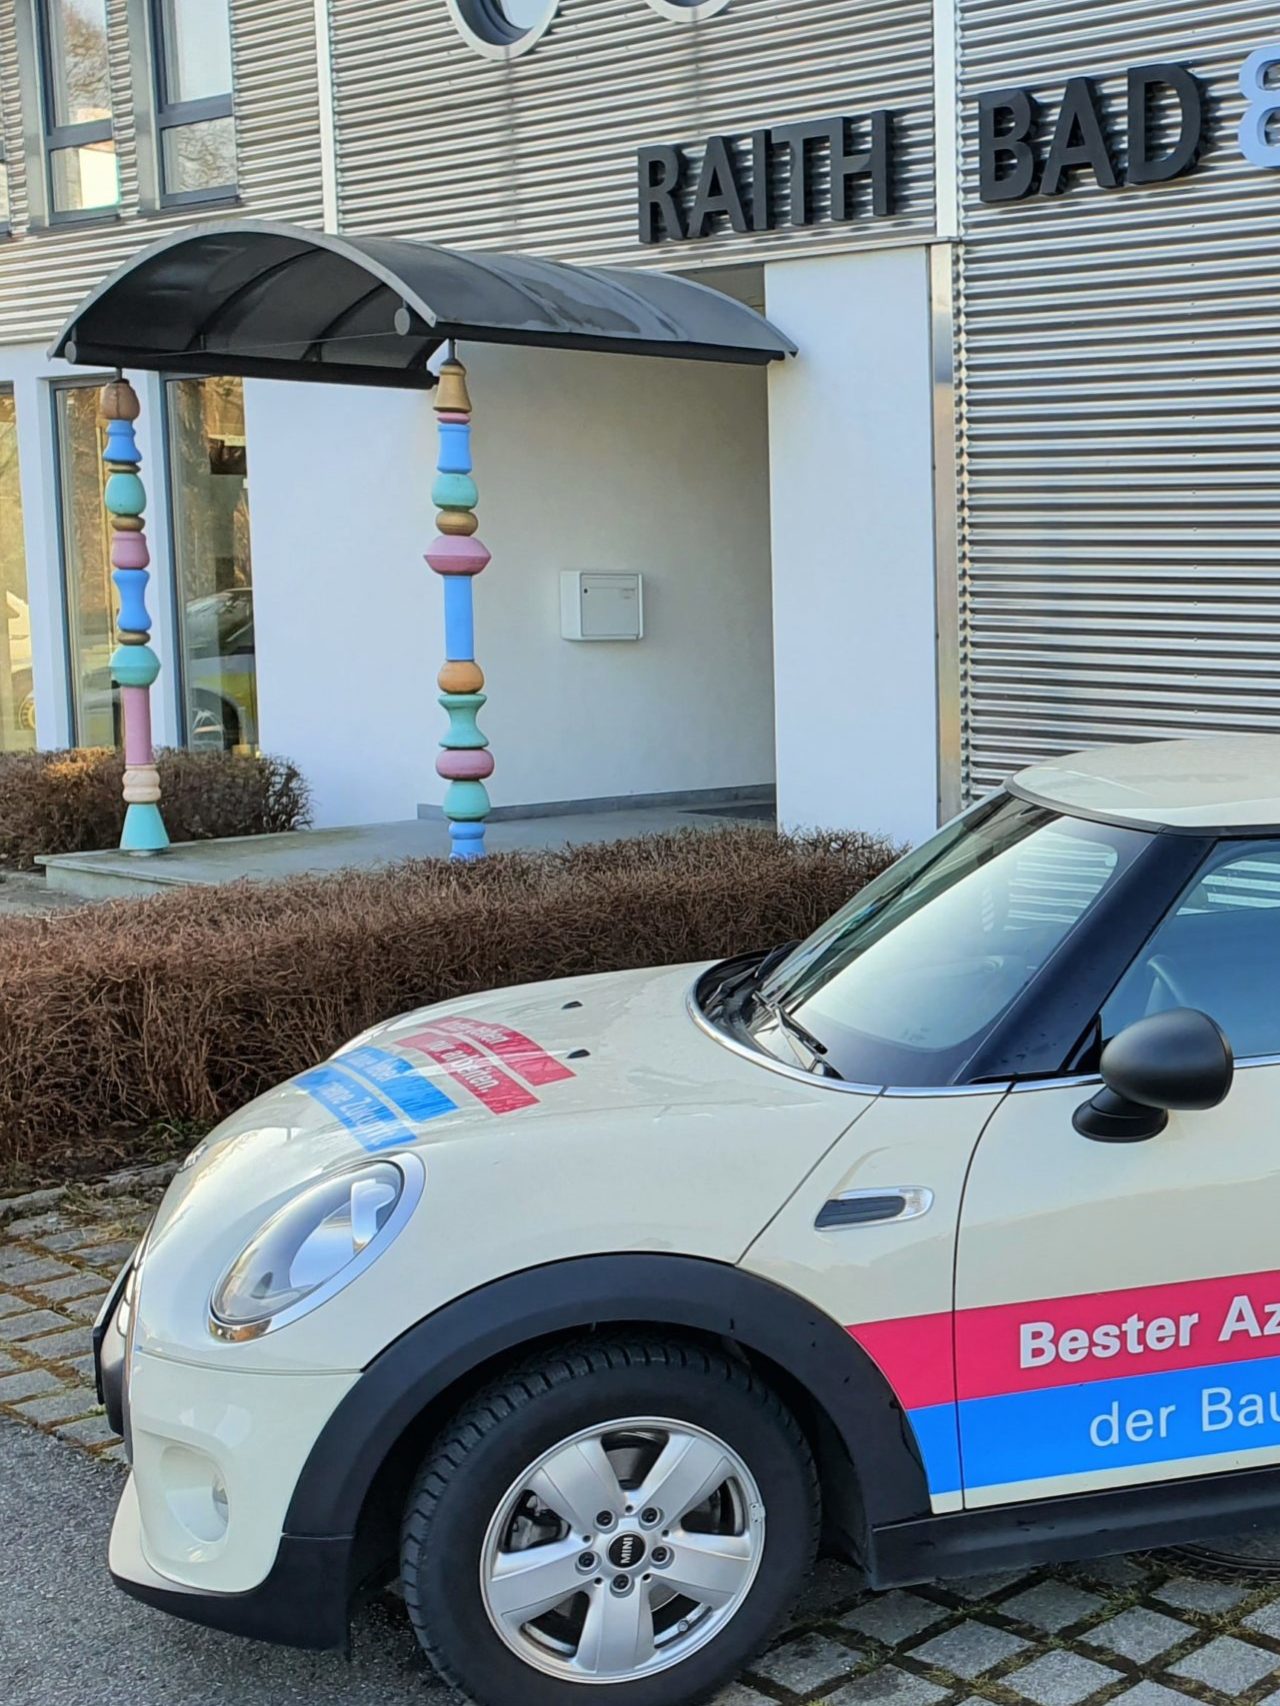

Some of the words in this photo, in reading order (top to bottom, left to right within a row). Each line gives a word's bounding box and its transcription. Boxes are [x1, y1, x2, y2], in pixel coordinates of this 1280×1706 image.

[637, 110, 895, 244] RAITH
[978, 62, 1206, 202] BAD
[1019, 1312, 1200, 1370] Bester
[1089, 1402, 1177, 1447] der
[620, 1537, 633, 1563] MINI
